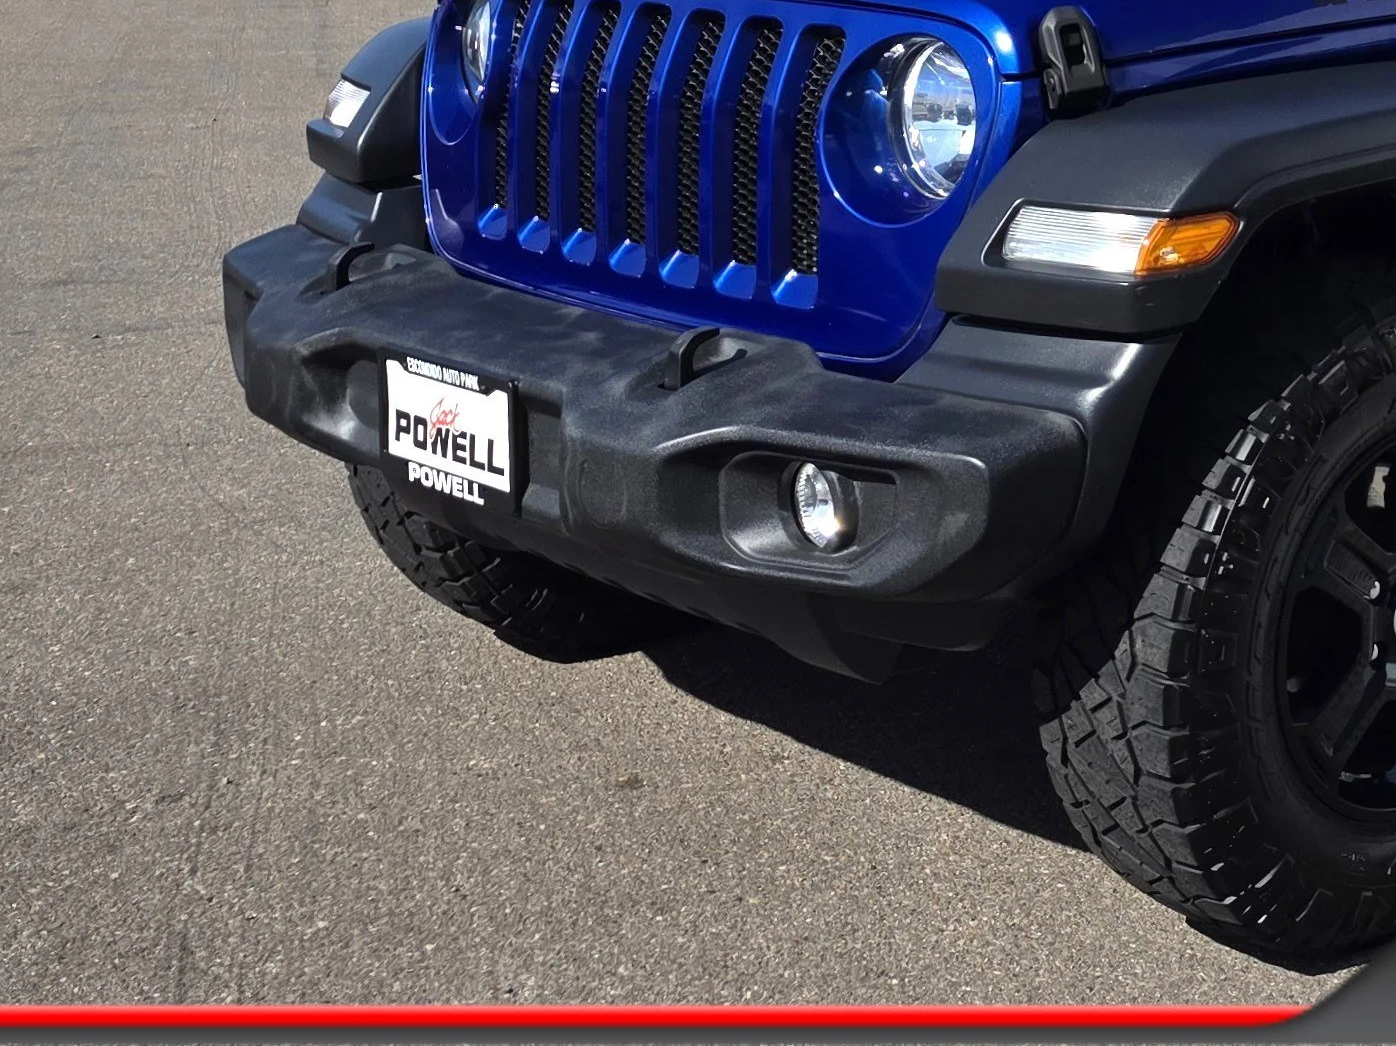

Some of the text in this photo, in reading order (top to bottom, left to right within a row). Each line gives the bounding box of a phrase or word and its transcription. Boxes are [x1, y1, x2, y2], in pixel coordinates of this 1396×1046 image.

[442, 367, 461, 386] AUTO
[460, 371, 480, 391] PARK
[429, 397, 462, 440] Jack
[394, 408, 505, 477] POWELL
[408, 461, 485, 506] POWELL
